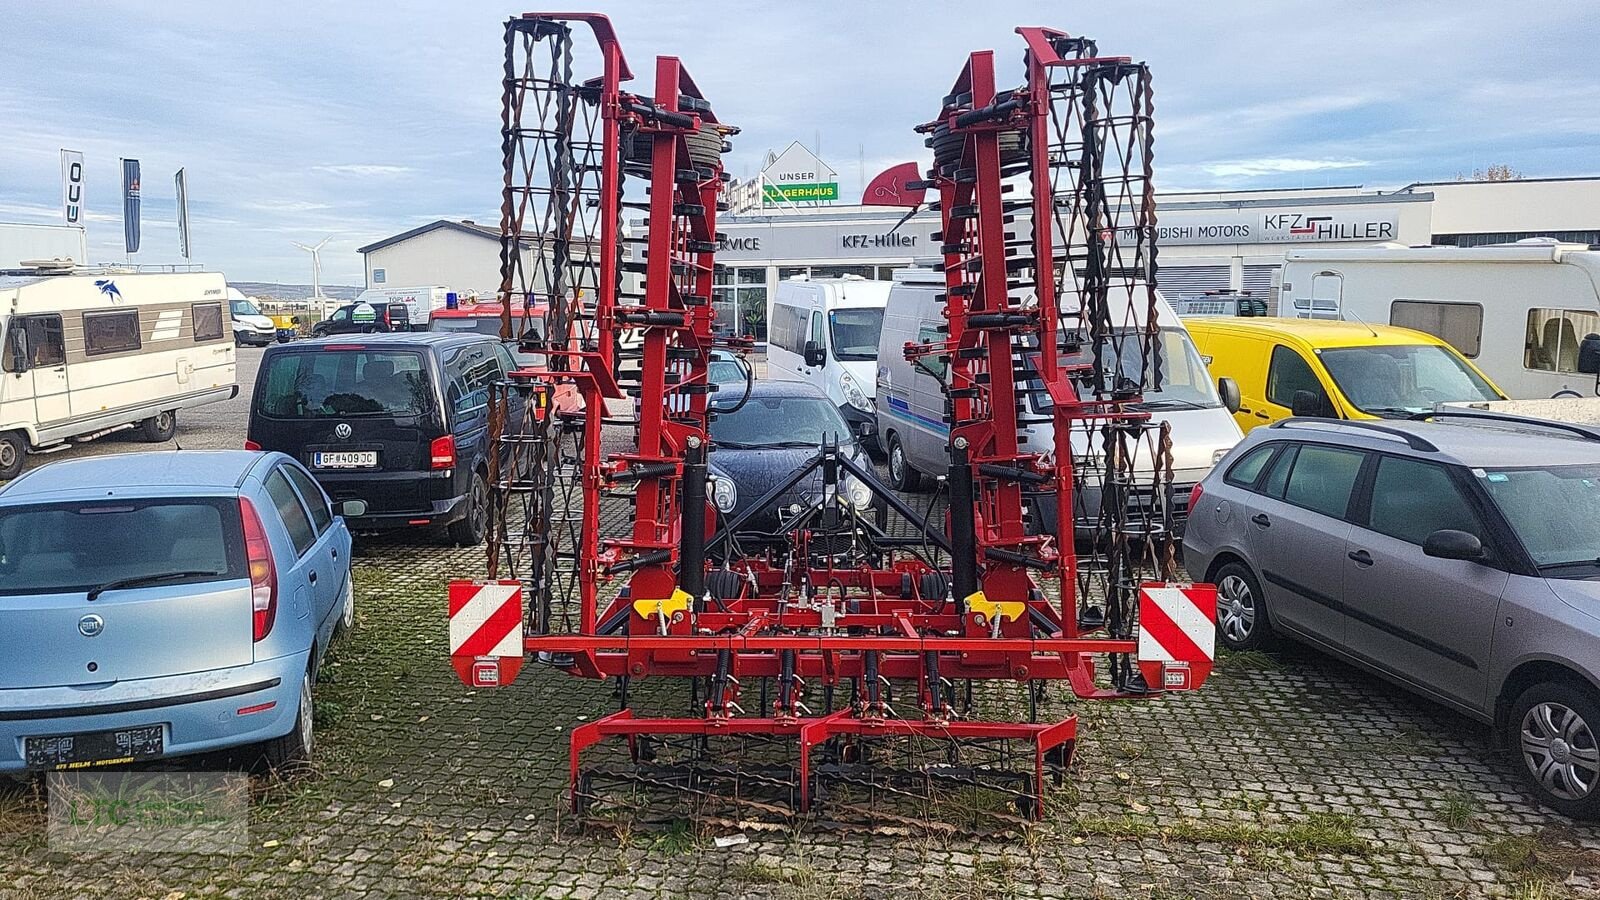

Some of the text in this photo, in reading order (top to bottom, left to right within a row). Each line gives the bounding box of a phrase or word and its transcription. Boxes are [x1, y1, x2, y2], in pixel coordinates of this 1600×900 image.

[779, 172, 815, 181] UNSER
[67, 162, 81, 223] ECO
[771, 187, 833, 197] LAGERHAUS
[1123, 225, 1250, 240] MISBISHI MOTORS
[1264, 214, 1392, 239] KFZ HILLER
[716, 238, 760, 251] RVICE
[842, 232, 918, 249] KFZ-Hiller
[323, 454, 335, 464] GF
[342, 453, 359, 463] 409
[95, 757, 135, 766] MOTORSPORT
